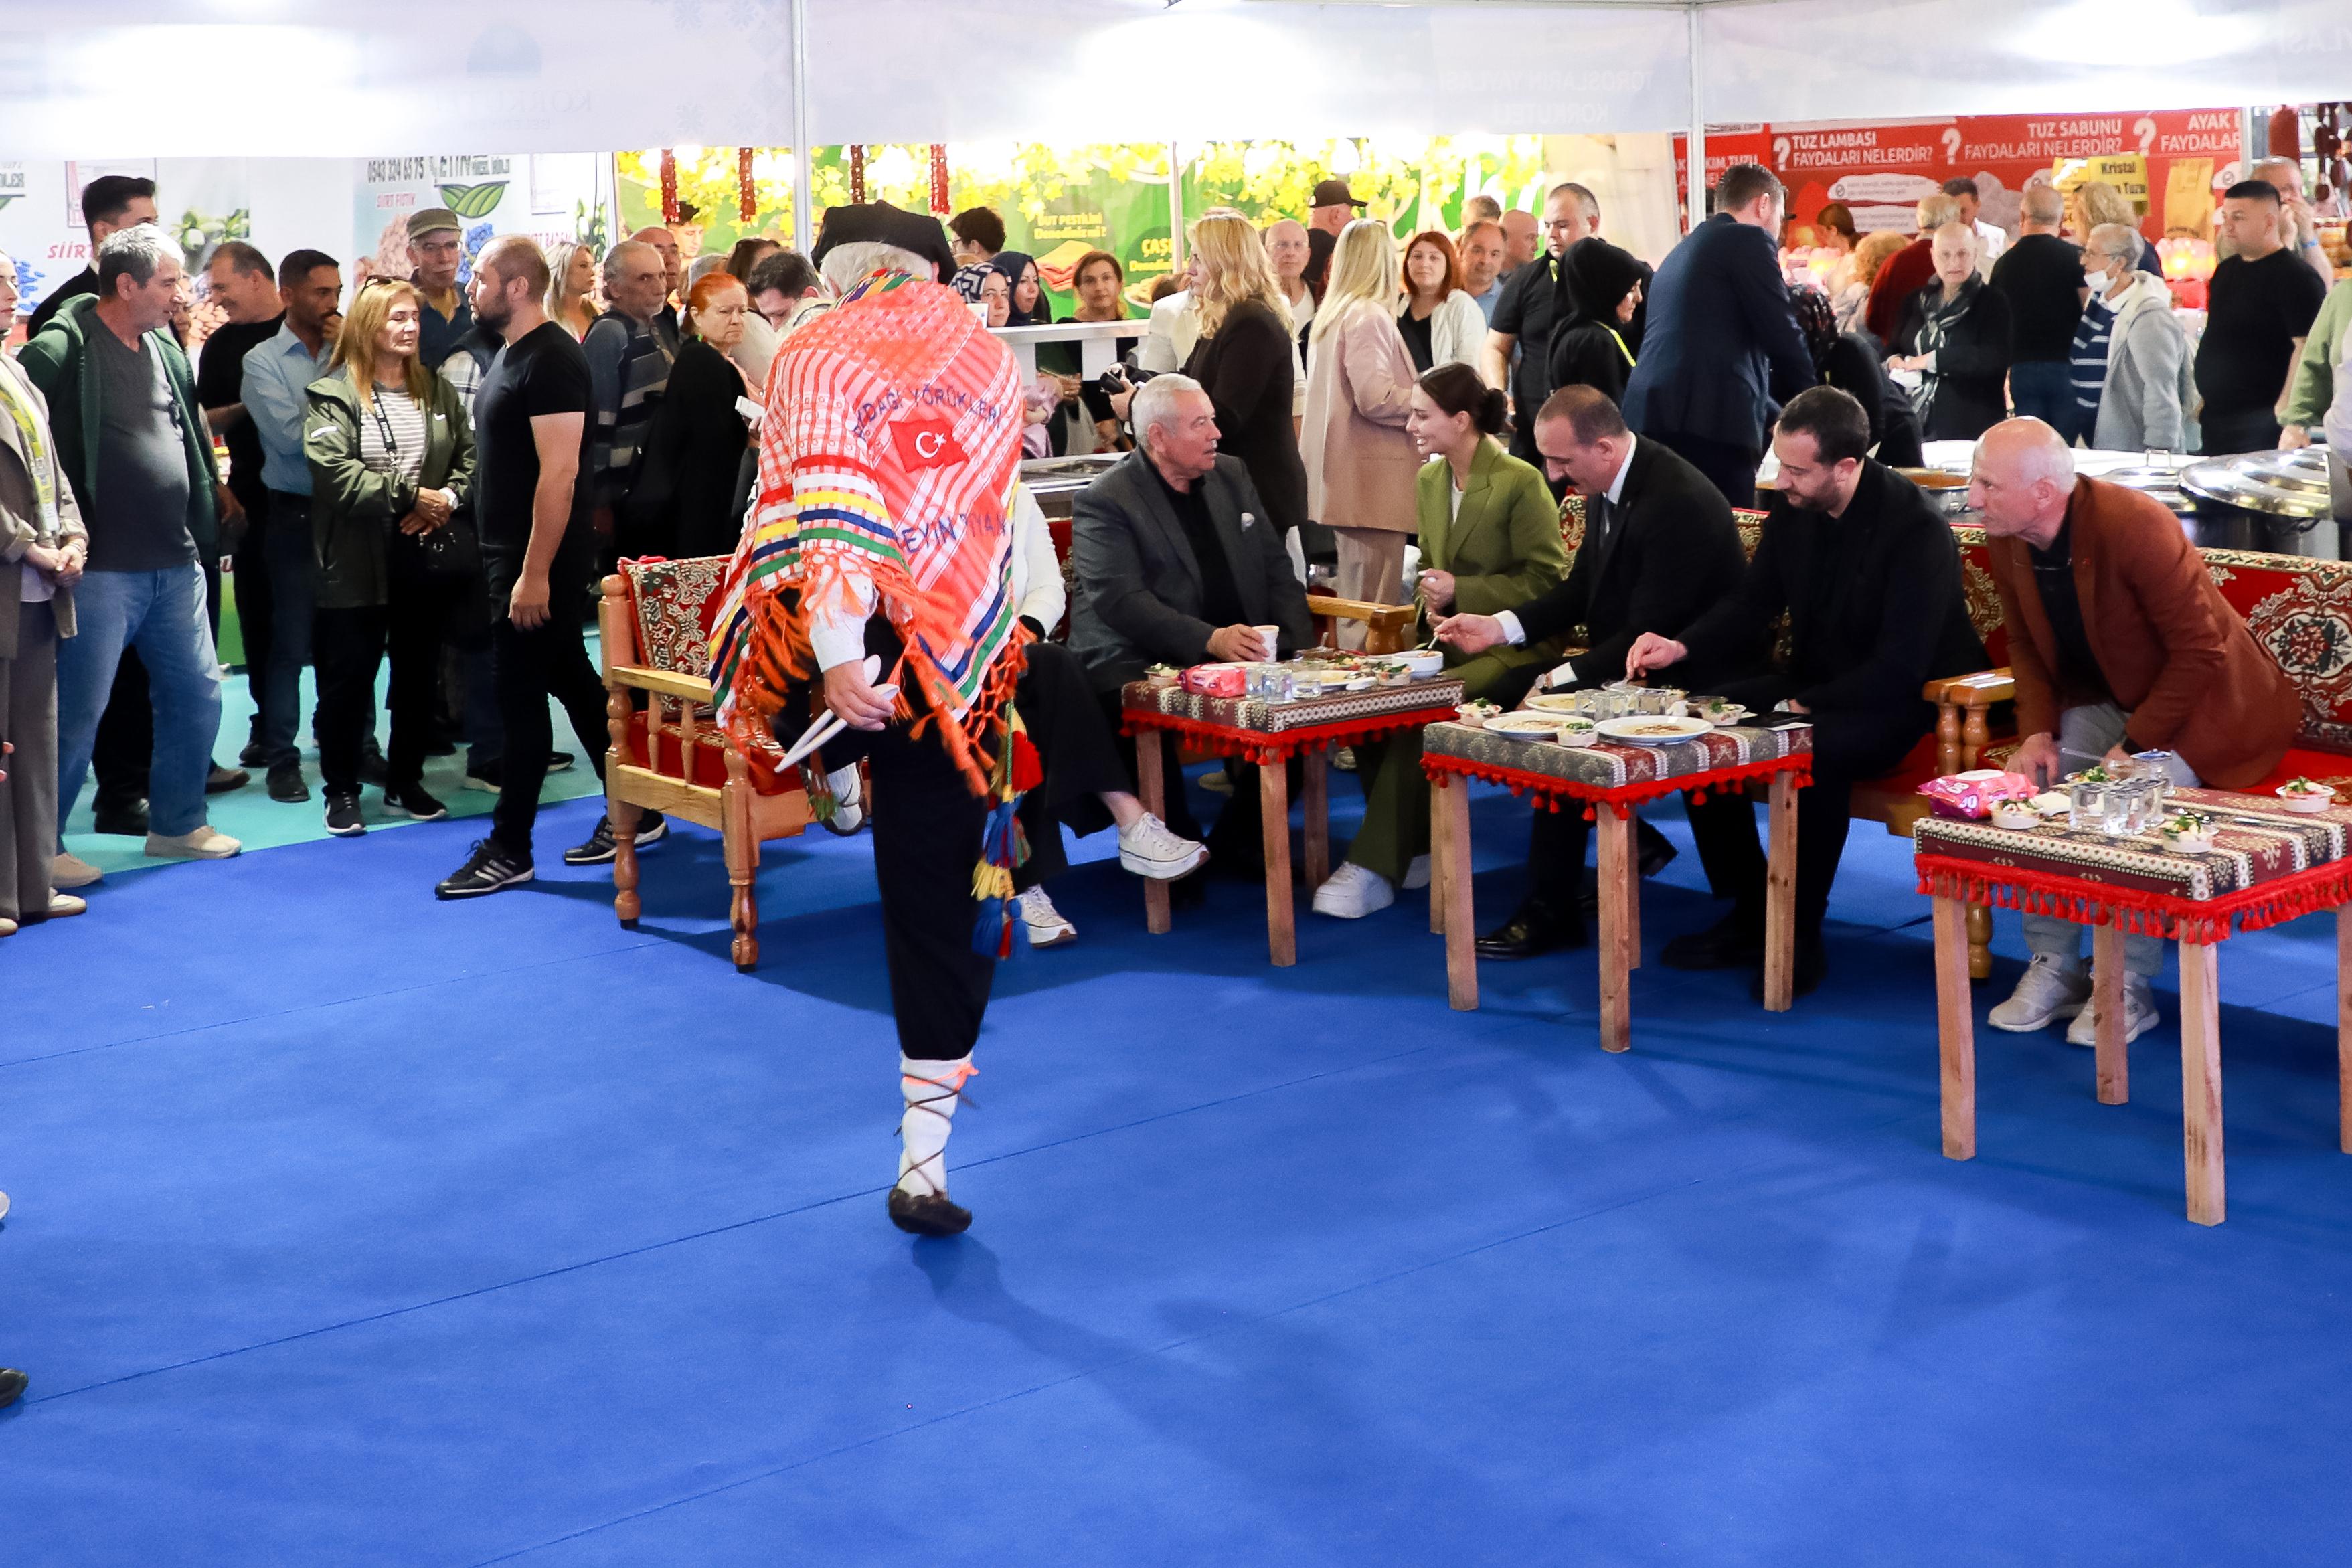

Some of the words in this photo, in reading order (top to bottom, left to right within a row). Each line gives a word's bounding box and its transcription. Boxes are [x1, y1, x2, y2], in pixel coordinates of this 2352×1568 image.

[2028, 122, 2057, 138] TUZ
[2060, 118, 2122, 136] SABUNU
[2187, 112, 2230, 131] AYAK
[1792, 135, 1817, 149] TUZ
[1820, 131, 1877, 148] LAMBASI
[1794, 149, 1861, 167] FAYDALARI
[1964, 143, 2039, 160] FAYDALARI
[2102, 162, 2136, 174] Kristal
